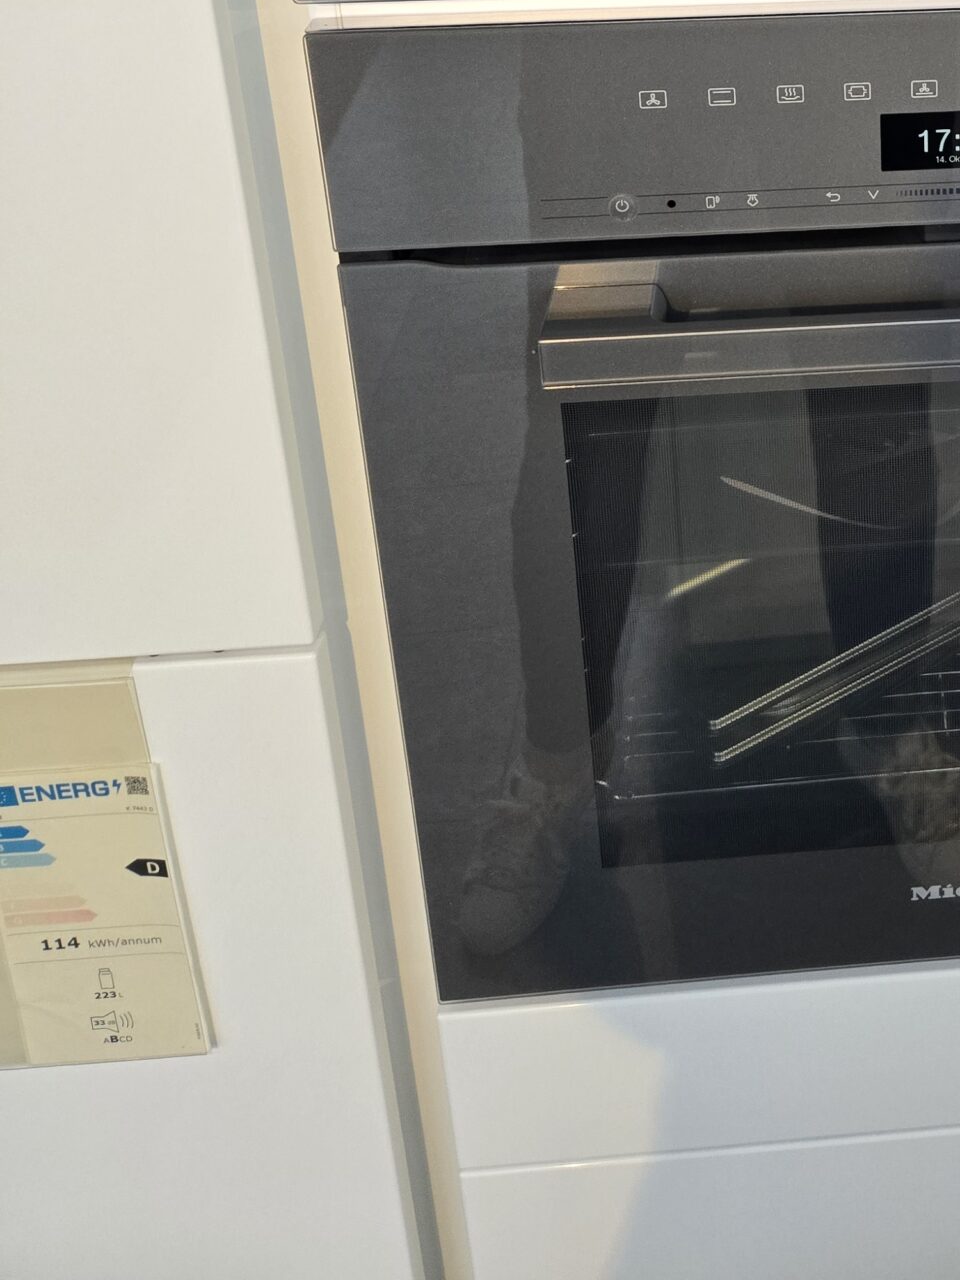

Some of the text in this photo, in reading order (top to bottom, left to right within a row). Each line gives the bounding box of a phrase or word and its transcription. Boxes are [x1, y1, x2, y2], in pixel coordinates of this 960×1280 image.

[936, 155, 947, 163] 14.
[18, 780, 110, 803] ENERG
[146, 861, 160, 874] D
[41, 936, 162, 951] 114 kWh/annum
[94, 991, 117, 1000] 223
[103, 1035, 133, 1044] ABCD
